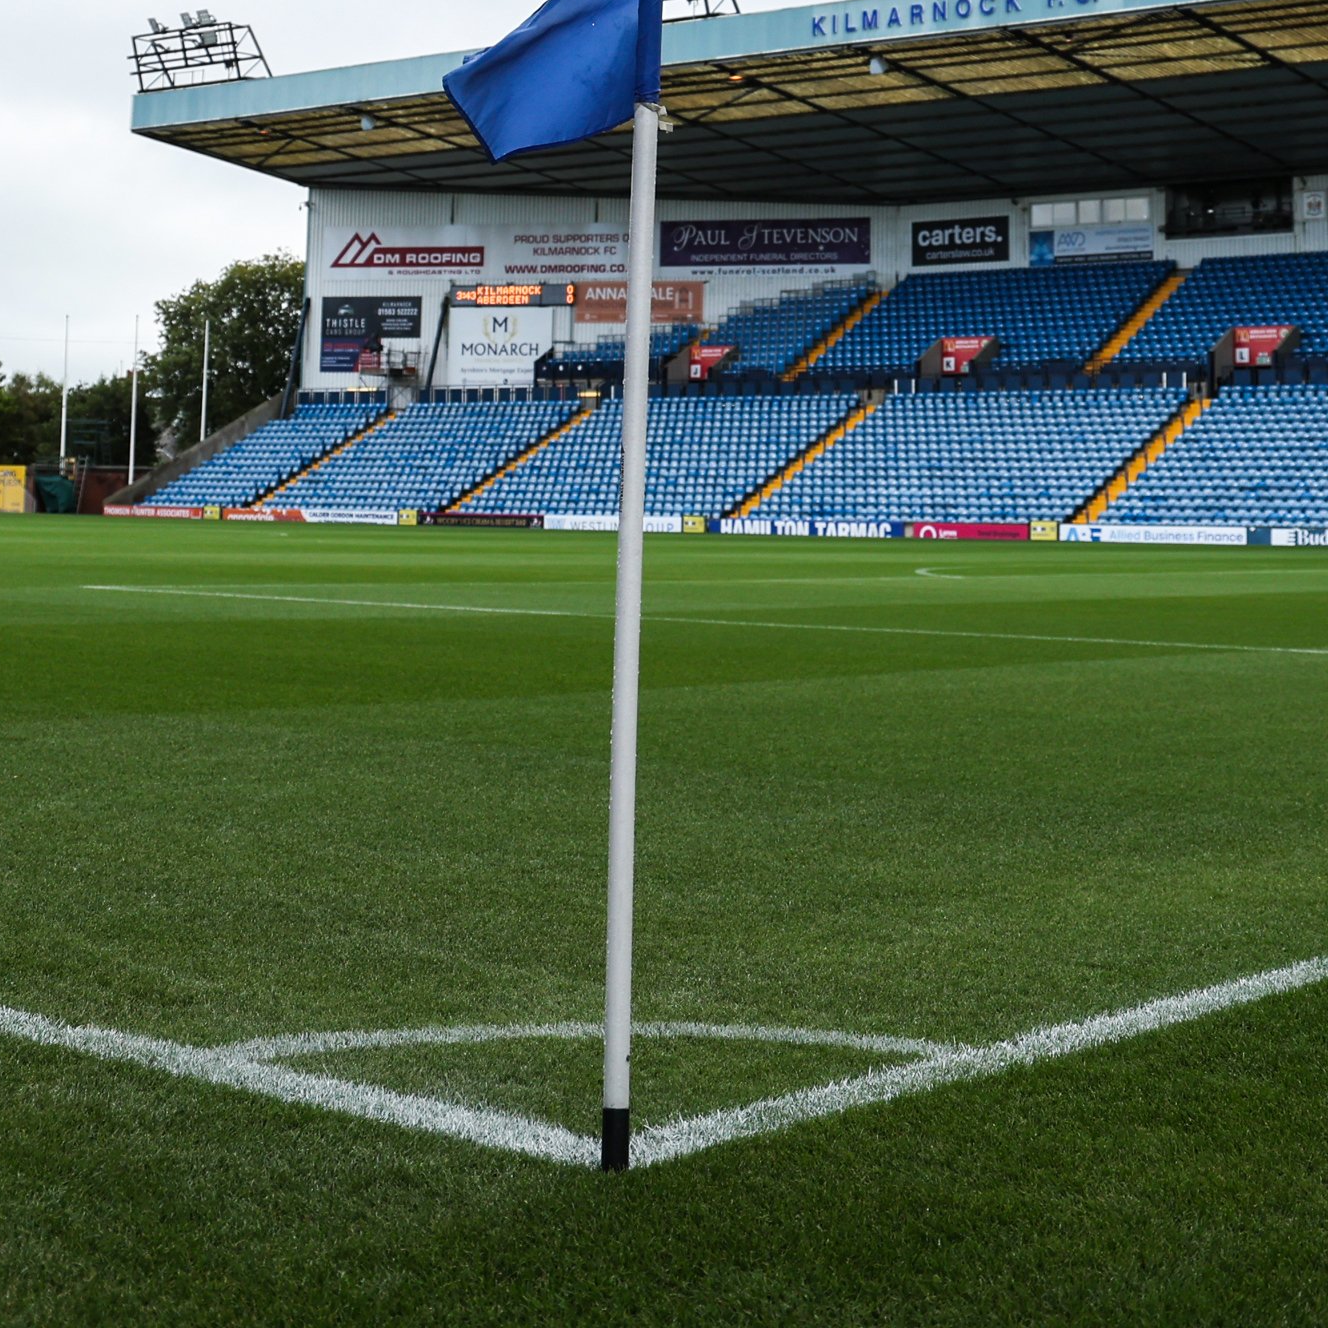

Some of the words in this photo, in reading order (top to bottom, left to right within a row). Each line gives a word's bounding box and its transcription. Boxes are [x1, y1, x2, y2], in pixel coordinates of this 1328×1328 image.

[514, 235, 549, 244] PROUD
[552, 234, 620, 244] SUPPORTERS
[672, 224, 731, 252] PAUL
[737, 223, 859, 250] STEVENSON
[918, 224, 1003, 247] carters.
[533, 246, 600, 256] KILMARNOCK
[604, 246, 617, 255] FC
[373, 253, 400, 264] DM
[405, 253, 481, 264] ROOFING
[690, 253, 748, 262] INDEPENDENT
[749, 253, 788, 262] FUNERAL
[790, 252, 838, 261] DIRECTORS
[504, 264, 628, 274] WWW.DMROOFING.CO.
[691, 266, 837, 276] www.funeral-scotland.co.uk
[477, 285, 542, 295] KILMARNOCK
[585, 287, 674, 301] ANNAALE
[477, 295, 529, 305] ABERDEEN
[326, 318, 366, 328] THISTLE
[492, 316, 508, 333] M
[461, 343, 539, 356] MONARCH
[103, 506, 131, 515] THOMSON
[156, 508, 190, 518] ASSOCIATES
[355, 512, 394, 520] MAINTENANCE
[720, 519, 809, 536] HAMILTON
[814, 521, 892, 538] TARMAC
[1109, 530, 1141, 541] Allied
[1144, 530, 1195, 541] Business
[1197, 531, 1244, 542] Finance
